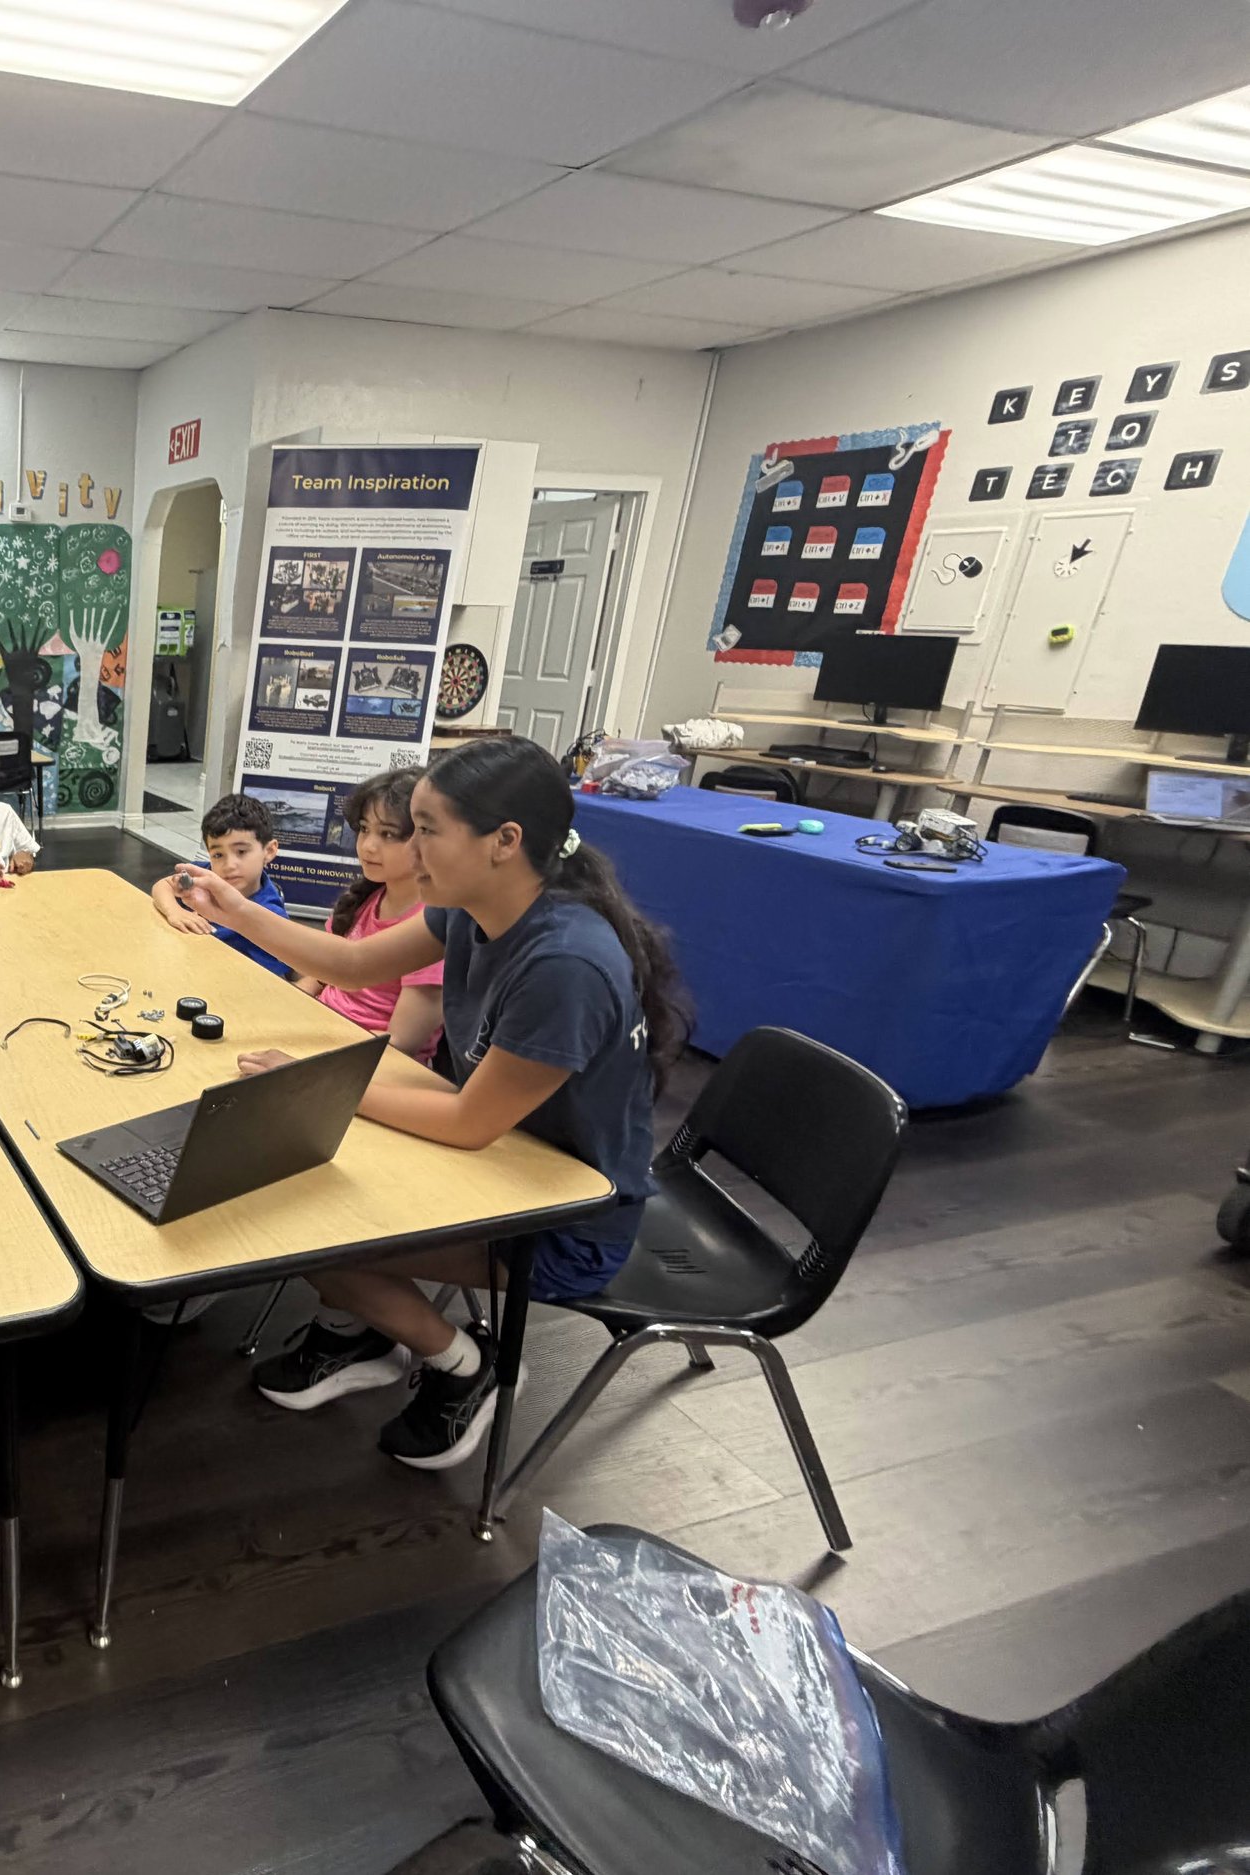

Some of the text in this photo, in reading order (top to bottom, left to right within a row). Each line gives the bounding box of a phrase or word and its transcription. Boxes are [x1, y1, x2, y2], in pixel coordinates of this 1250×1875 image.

[174, 422, 198, 461] EXIT
[1066, 421, 1141, 447] TO
[291, 473, 450, 493] Team Inspiration
[985, 460, 1204, 493] TECH
[377, 553, 420, 561] Autonomous
[306, 867, 316, 875] TO
